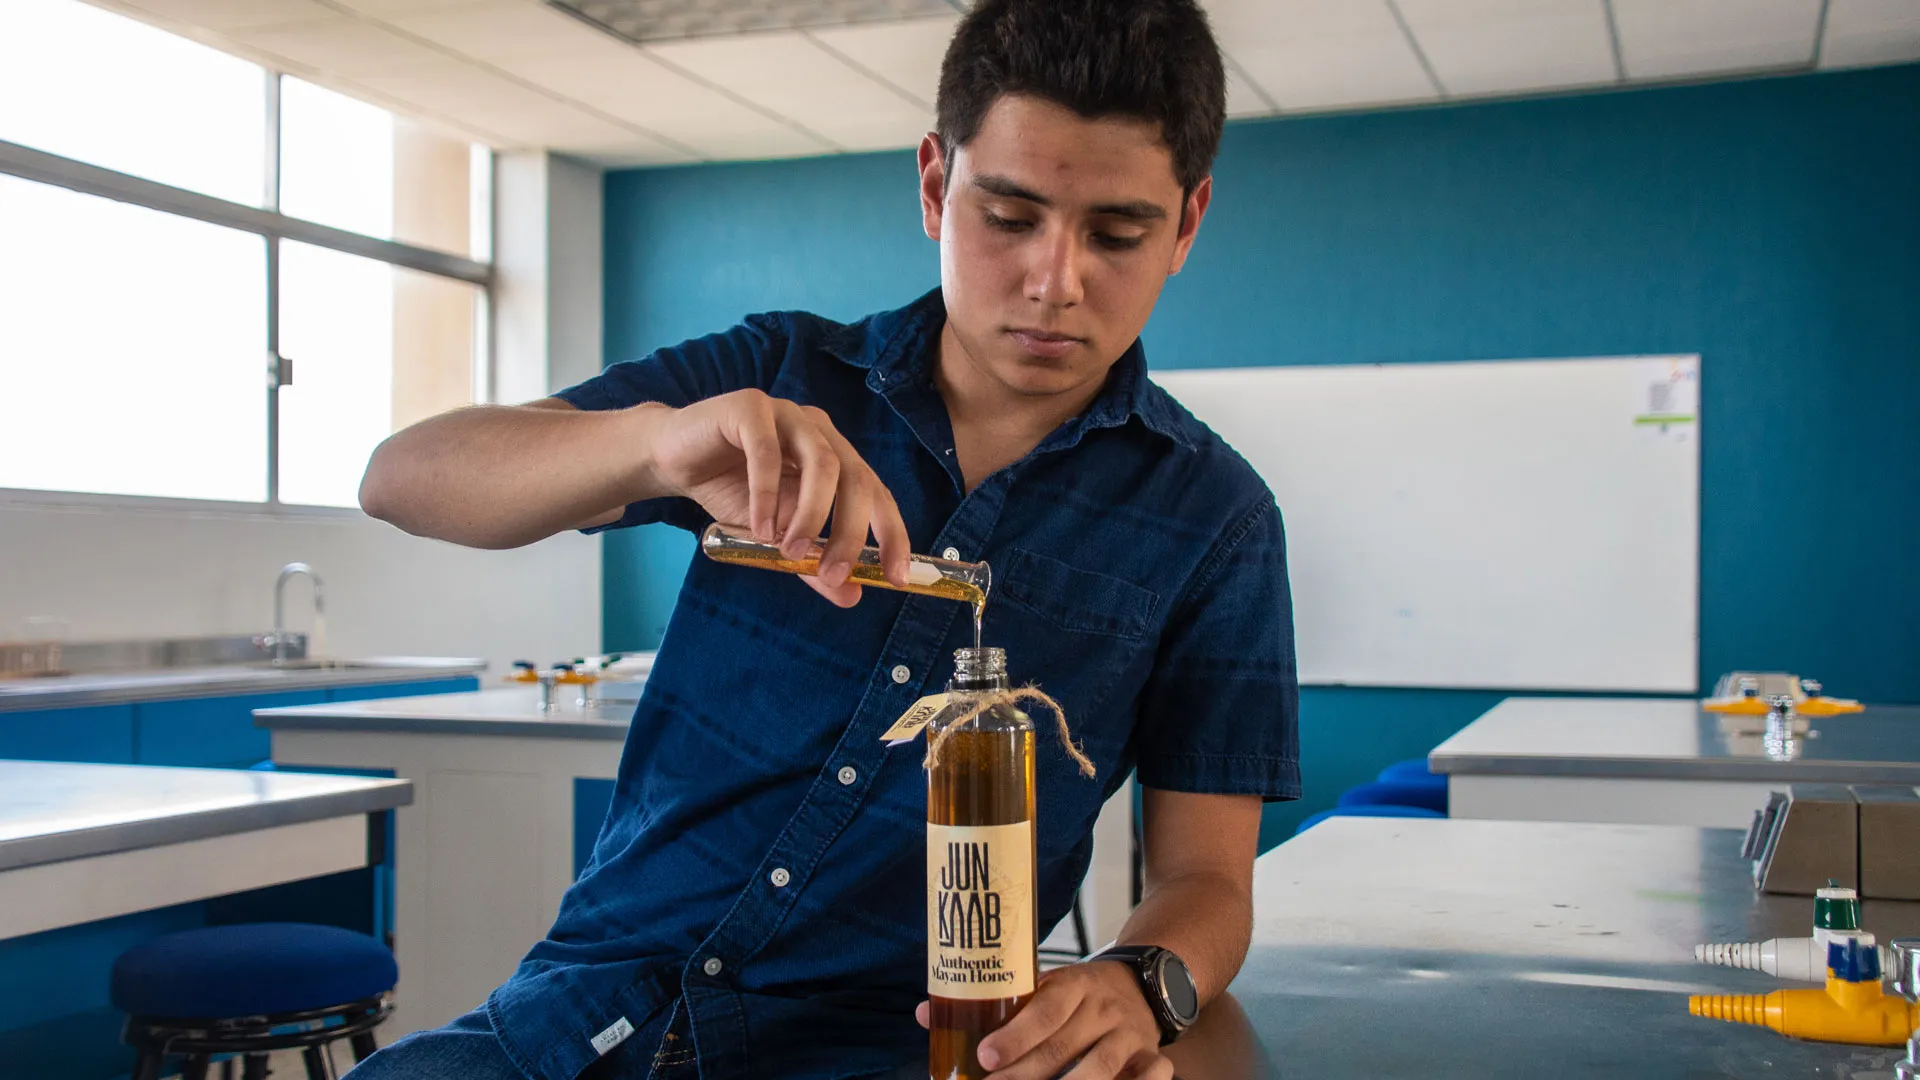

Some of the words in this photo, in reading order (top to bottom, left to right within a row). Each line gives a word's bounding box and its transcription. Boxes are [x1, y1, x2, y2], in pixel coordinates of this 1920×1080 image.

[941, 842, 989, 891] JUN
[938, 891, 1002, 949] KAAB
[932, 966, 967, 985] Mayan
[971, 969, 1016, 985] Honey
[938, 954, 1004, 969] Authentic
